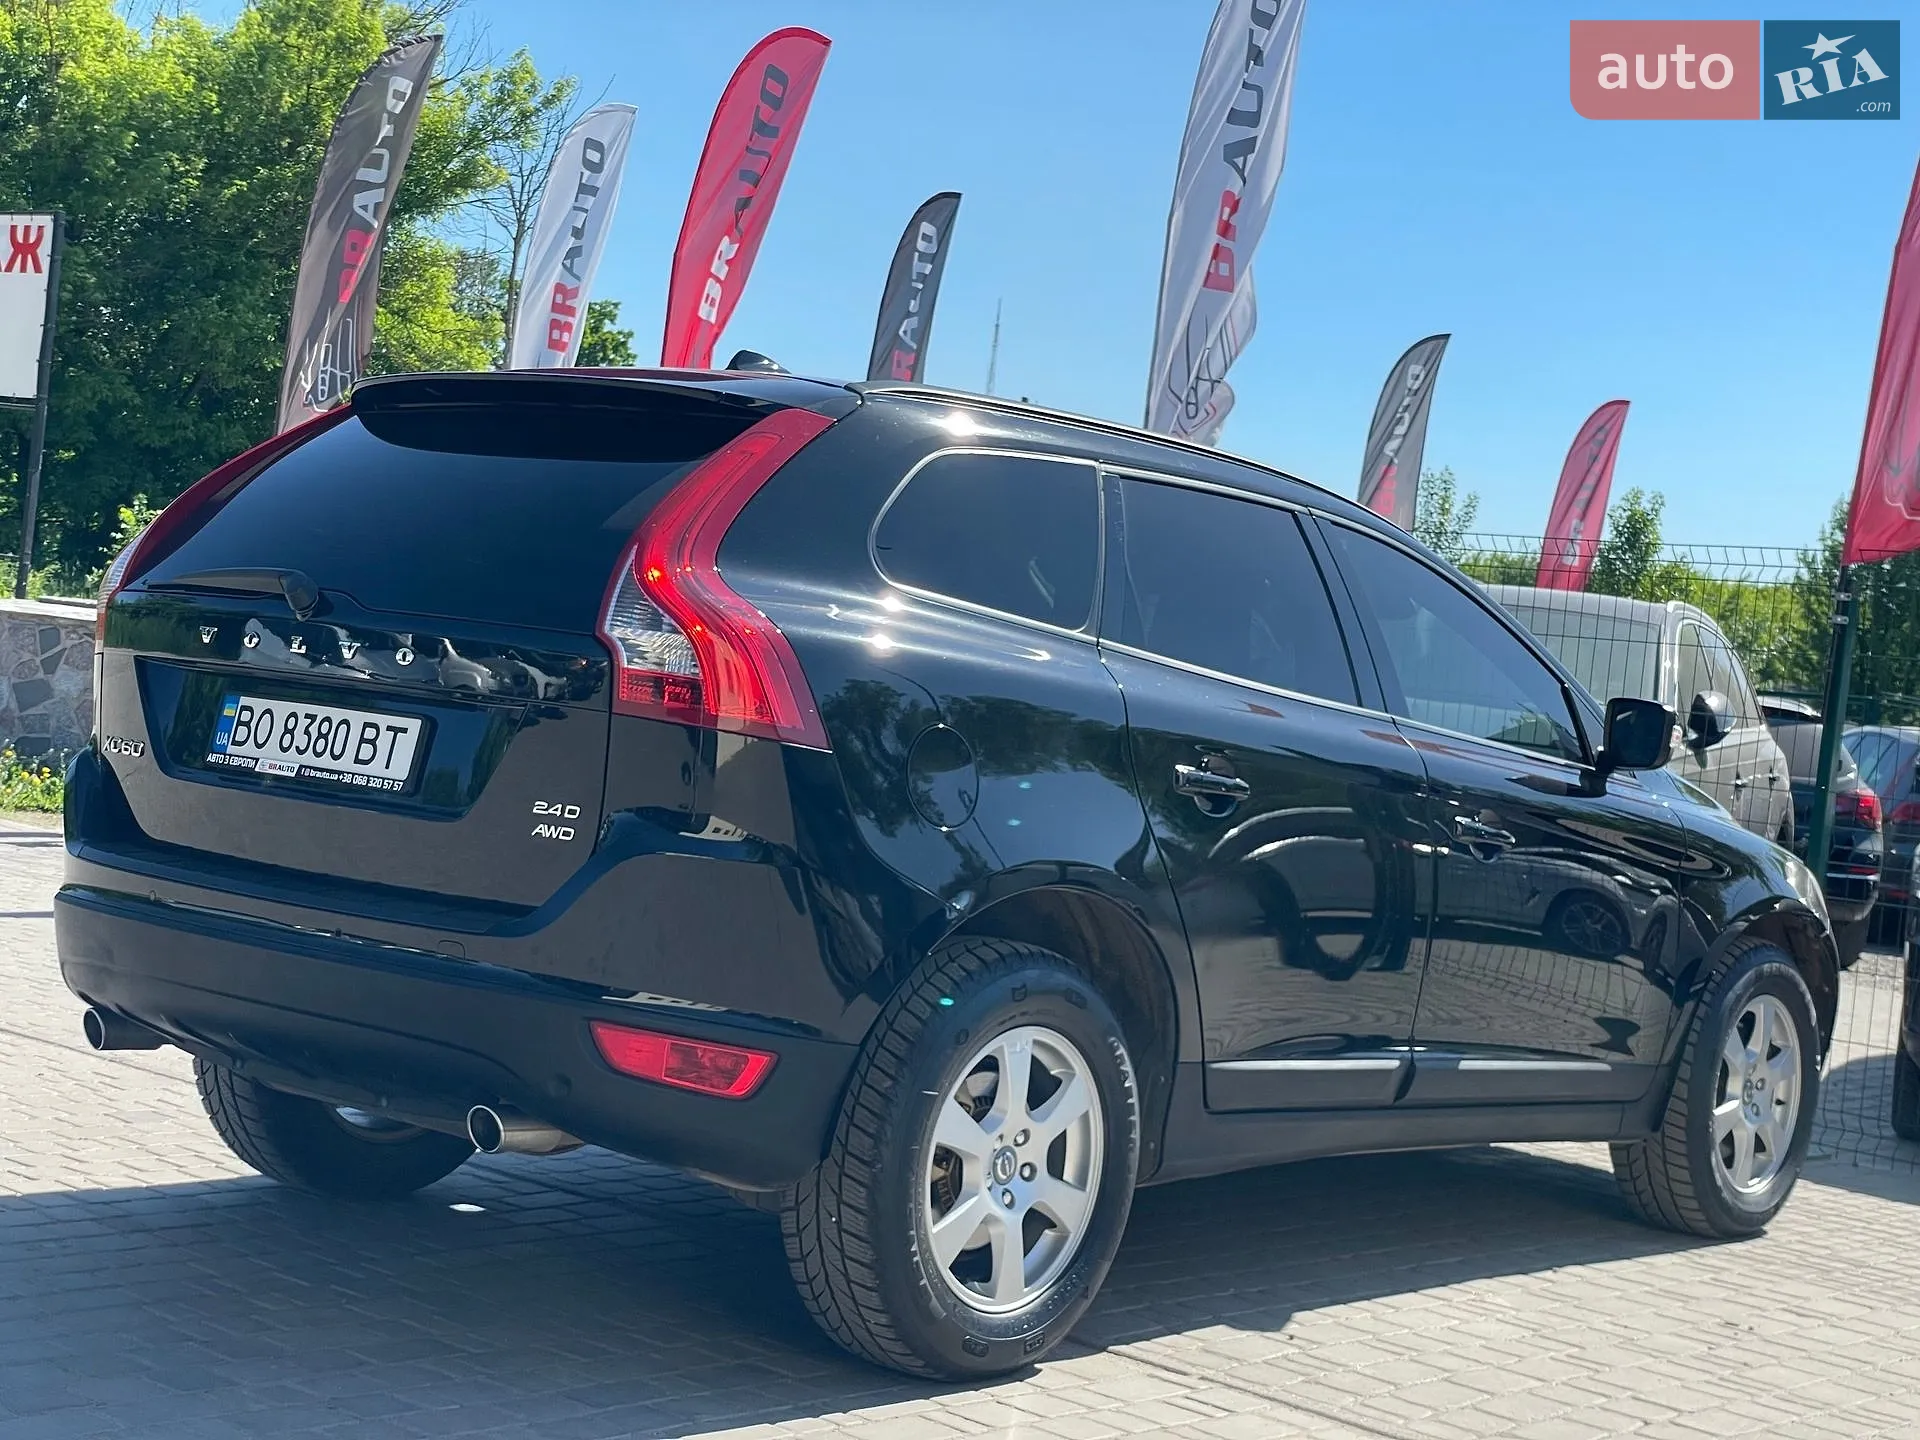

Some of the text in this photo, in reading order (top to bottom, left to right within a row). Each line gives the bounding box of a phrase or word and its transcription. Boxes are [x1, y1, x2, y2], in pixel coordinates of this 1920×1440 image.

[698, 63, 790, 325] BRAUTO
[0, 224, 45, 274] Ж
[547, 136, 606, 353] BRAUTO
[891, 221, 938, 382] RAUTO
[199, 625, 416, 667] VOLVO
[102, 735, 145, 757] XC60
[215, 731, 229, 746] UA
[230, 704, 409, 770] BO 8380 BT
[268, 762, 295, 773] BRAUTO
[339, 773, 352, 784] +38
[368, 778, 382, 788] 320
[382, 780, 393, 790] 57
[393, 782, 404, 791] 57
[531, 823, 576, 841] AWD
